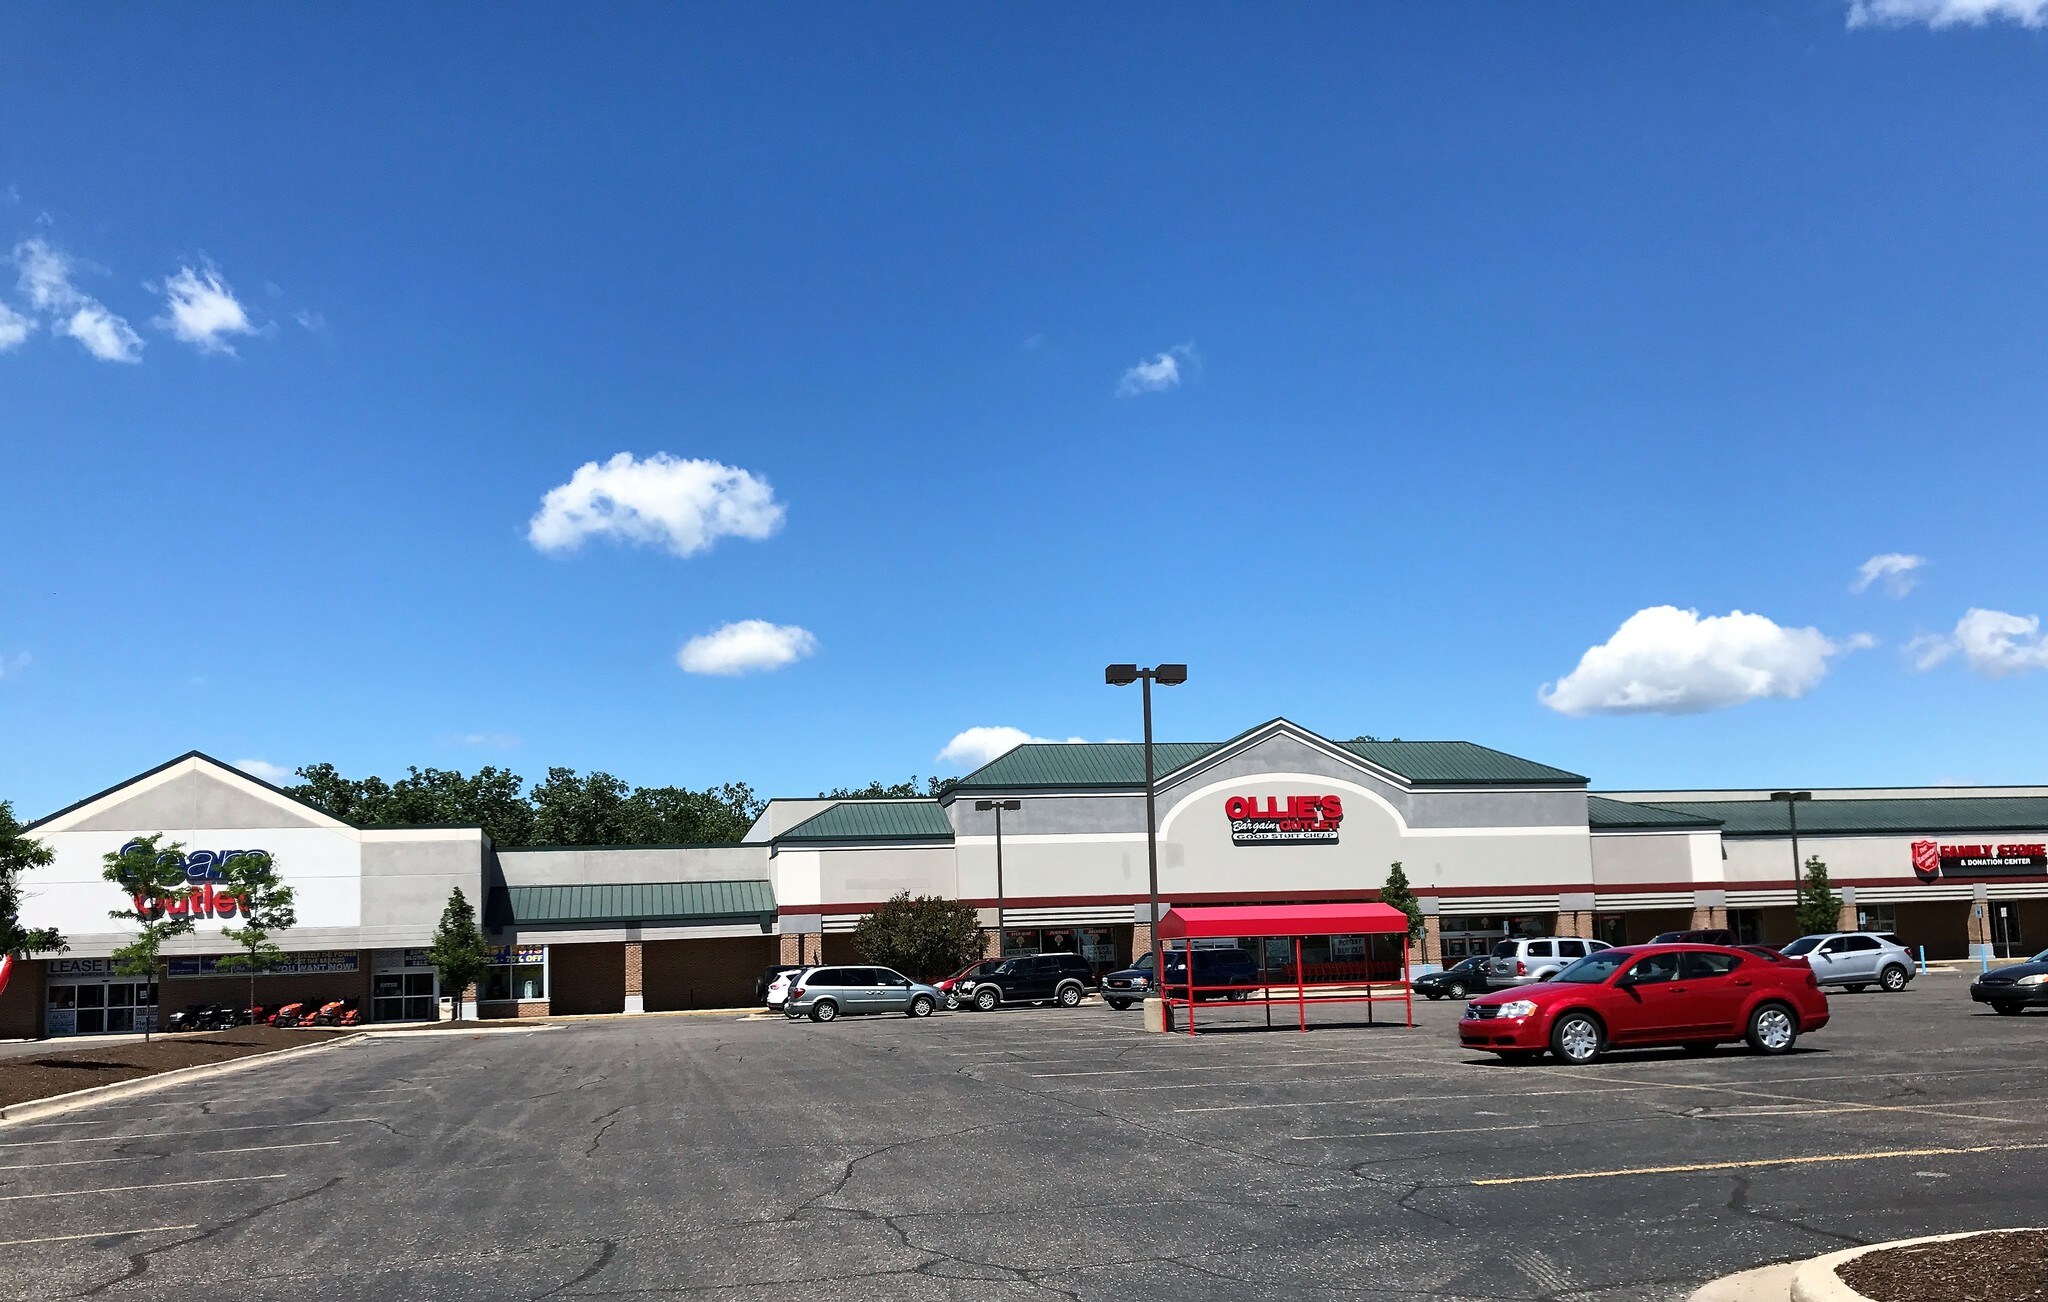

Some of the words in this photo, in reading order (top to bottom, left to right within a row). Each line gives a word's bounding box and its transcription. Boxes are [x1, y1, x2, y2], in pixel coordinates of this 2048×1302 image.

[1225, 795, 1343, 820] OLLIE'S
[1232, 819, 1276, 833] Bargain
[1279, 819, 1340, 831] OUTLET
[1940, 845, 1993, 858] FAMILY
[1997, 844, 2047, 857] STORE
[525, 954, 544, 962] OFF
[50, 960, 102, 973] LEASE
[275, 965, 295, 973] YOU
[299, 964, 327, 972] WANT
[328, 962, 355, 971] NOW!
